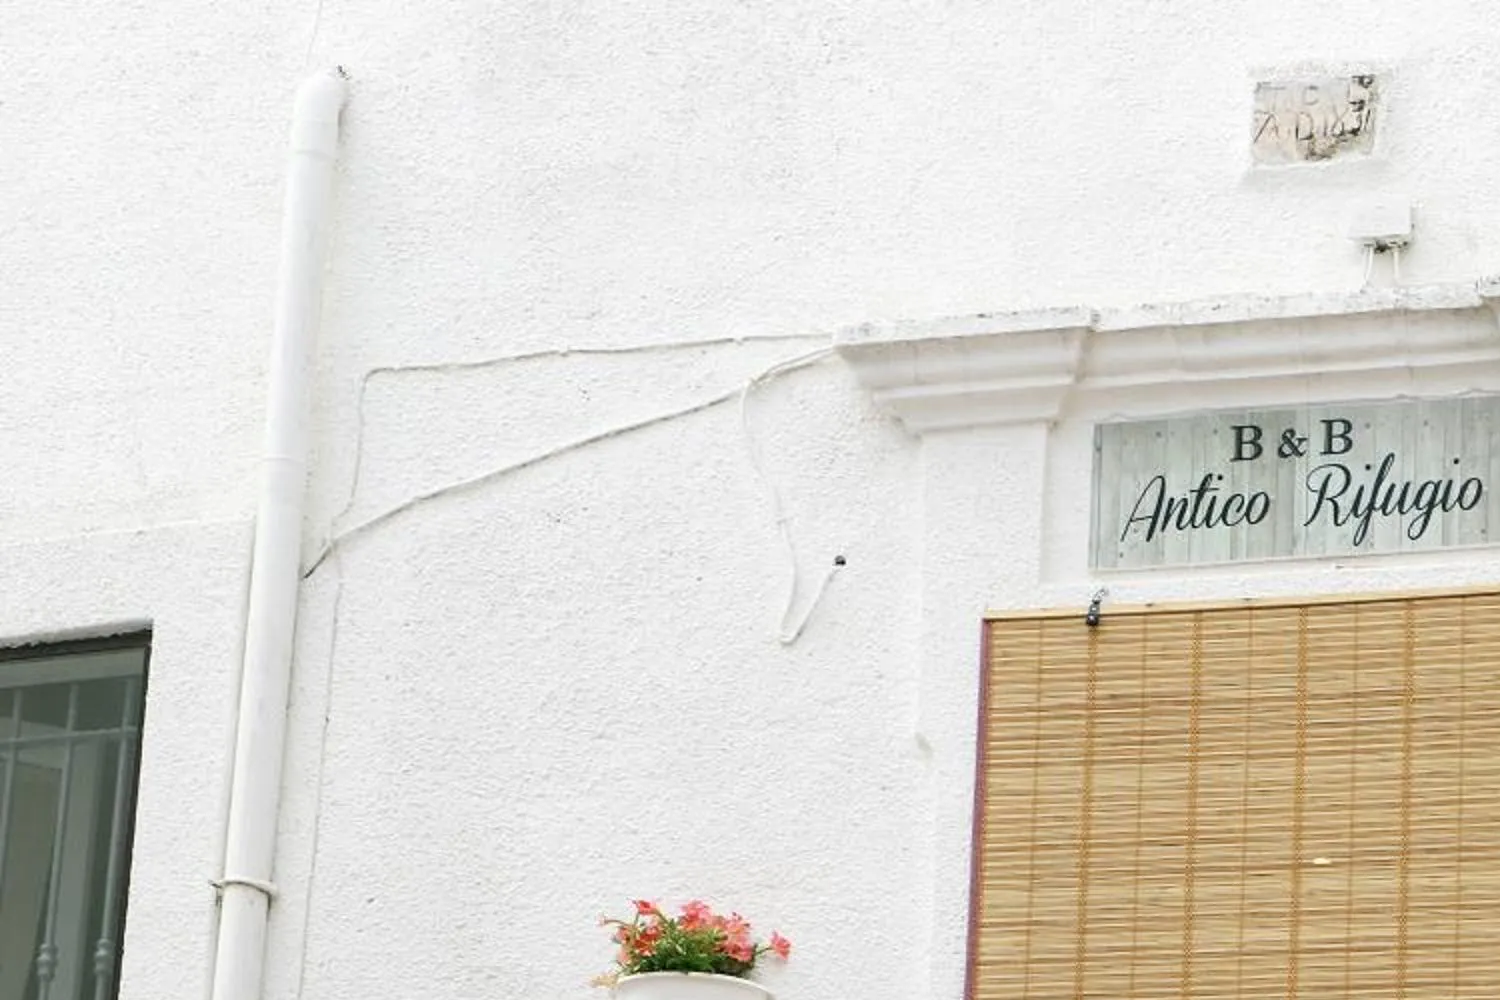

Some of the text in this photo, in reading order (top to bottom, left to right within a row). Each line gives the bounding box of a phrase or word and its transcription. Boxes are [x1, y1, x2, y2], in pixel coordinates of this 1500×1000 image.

[1230, 418, 1353, 462] B & B
[1120, 452, 1483, 546] Antico Rifugio
